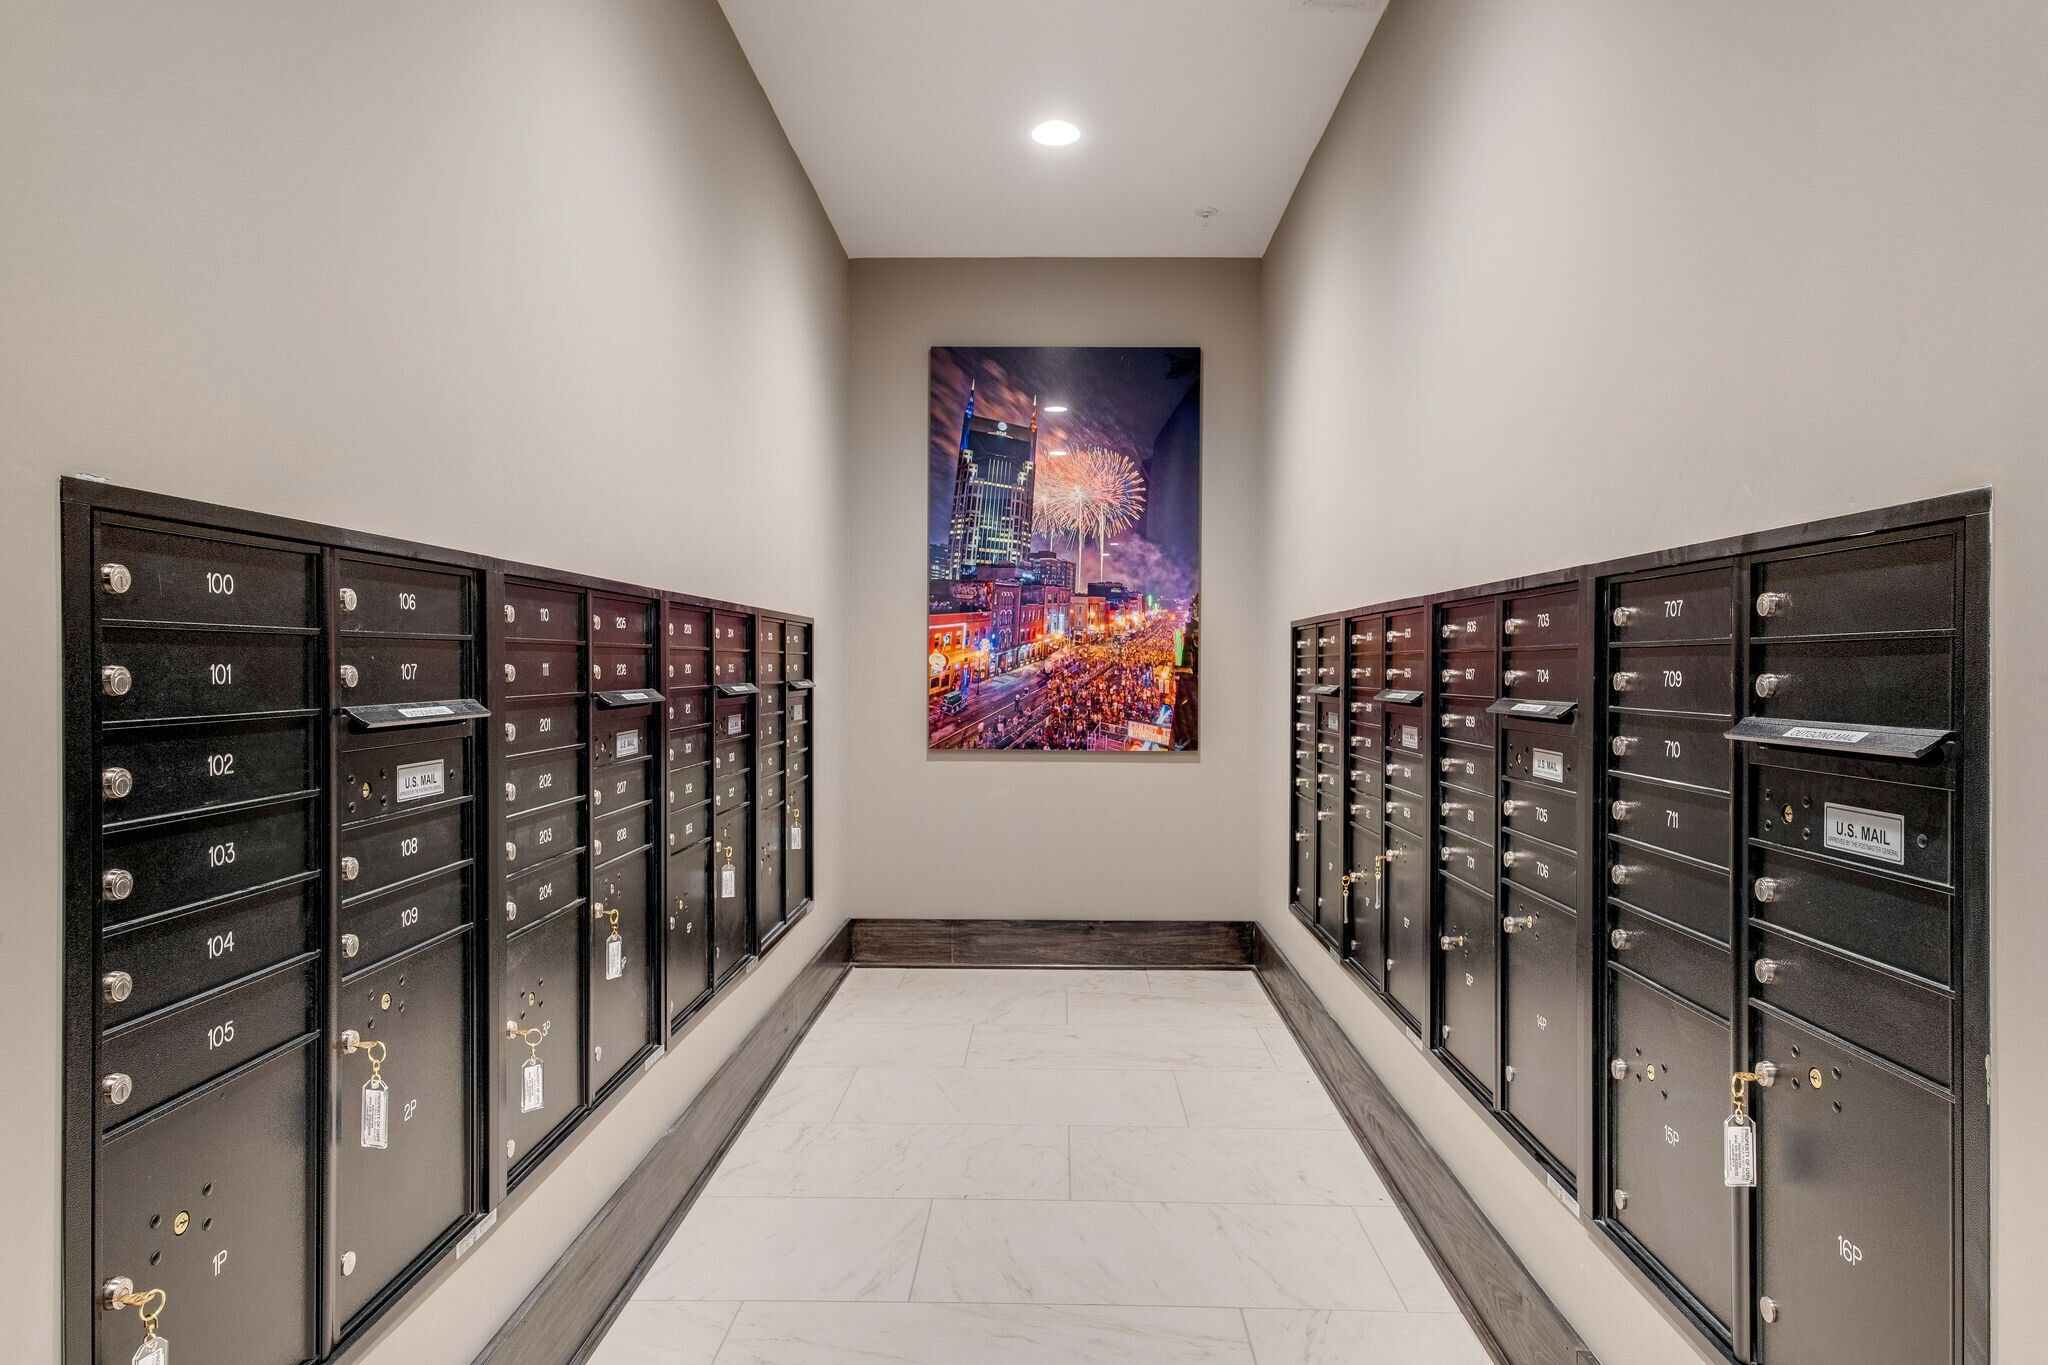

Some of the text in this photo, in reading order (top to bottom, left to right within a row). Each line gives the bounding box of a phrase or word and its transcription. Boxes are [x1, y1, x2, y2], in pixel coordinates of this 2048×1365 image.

[207, 572, 233, 594] 100
[399, 593, 415, 610] 106
[1665, 600, 1683, 617] 707
[540, 608, 549, 621] 110
[616, 617, 626, 628] 205
[1538, 614, 1549, 627] 703
[210, 664, 231, 684] 101
[401, 664, 417, 680] 107
[617, 664, 626, 675] 206
[1537, 669, 1549, 682] 704
[1664, 671, 1682, 687] 709
[540, 718, 550, 731] 201
[1790, 730, 1836, 739] OUTGOING
[1665, 740, 1680, 757] 710
[208, 754, 234, 776] 102
[404, 773, 437, 789] U.S. MAIL
[539, 774, 551, 788] 202
[617, 781, 626, 794] 207
[1536, 807, 1547, 822] 705
[1666, 810, 1678, 828] 711
[540, 828, 552, 844] 203
[617, 828, 626, 841] 208
[1836, 821, 1890, 845] U.S. MAIL
[209, 842, 235, 867] 103
[401, 838, 417, 856] 108
[1537, 862, 1548, 878] 706
[540, 883, 552, 900] 204
[401, 907, 418, 927] 109
[207, 932, 234, 958] 104
[208, 1021, 234, 1050] 105
[404, 1099, 416, 1121] 2P
[1664, 1125, 1679, 1146] 15P
[1838, 1235, 1862, 1265] 16P
[213, 1250, 227, 1276] 1P
